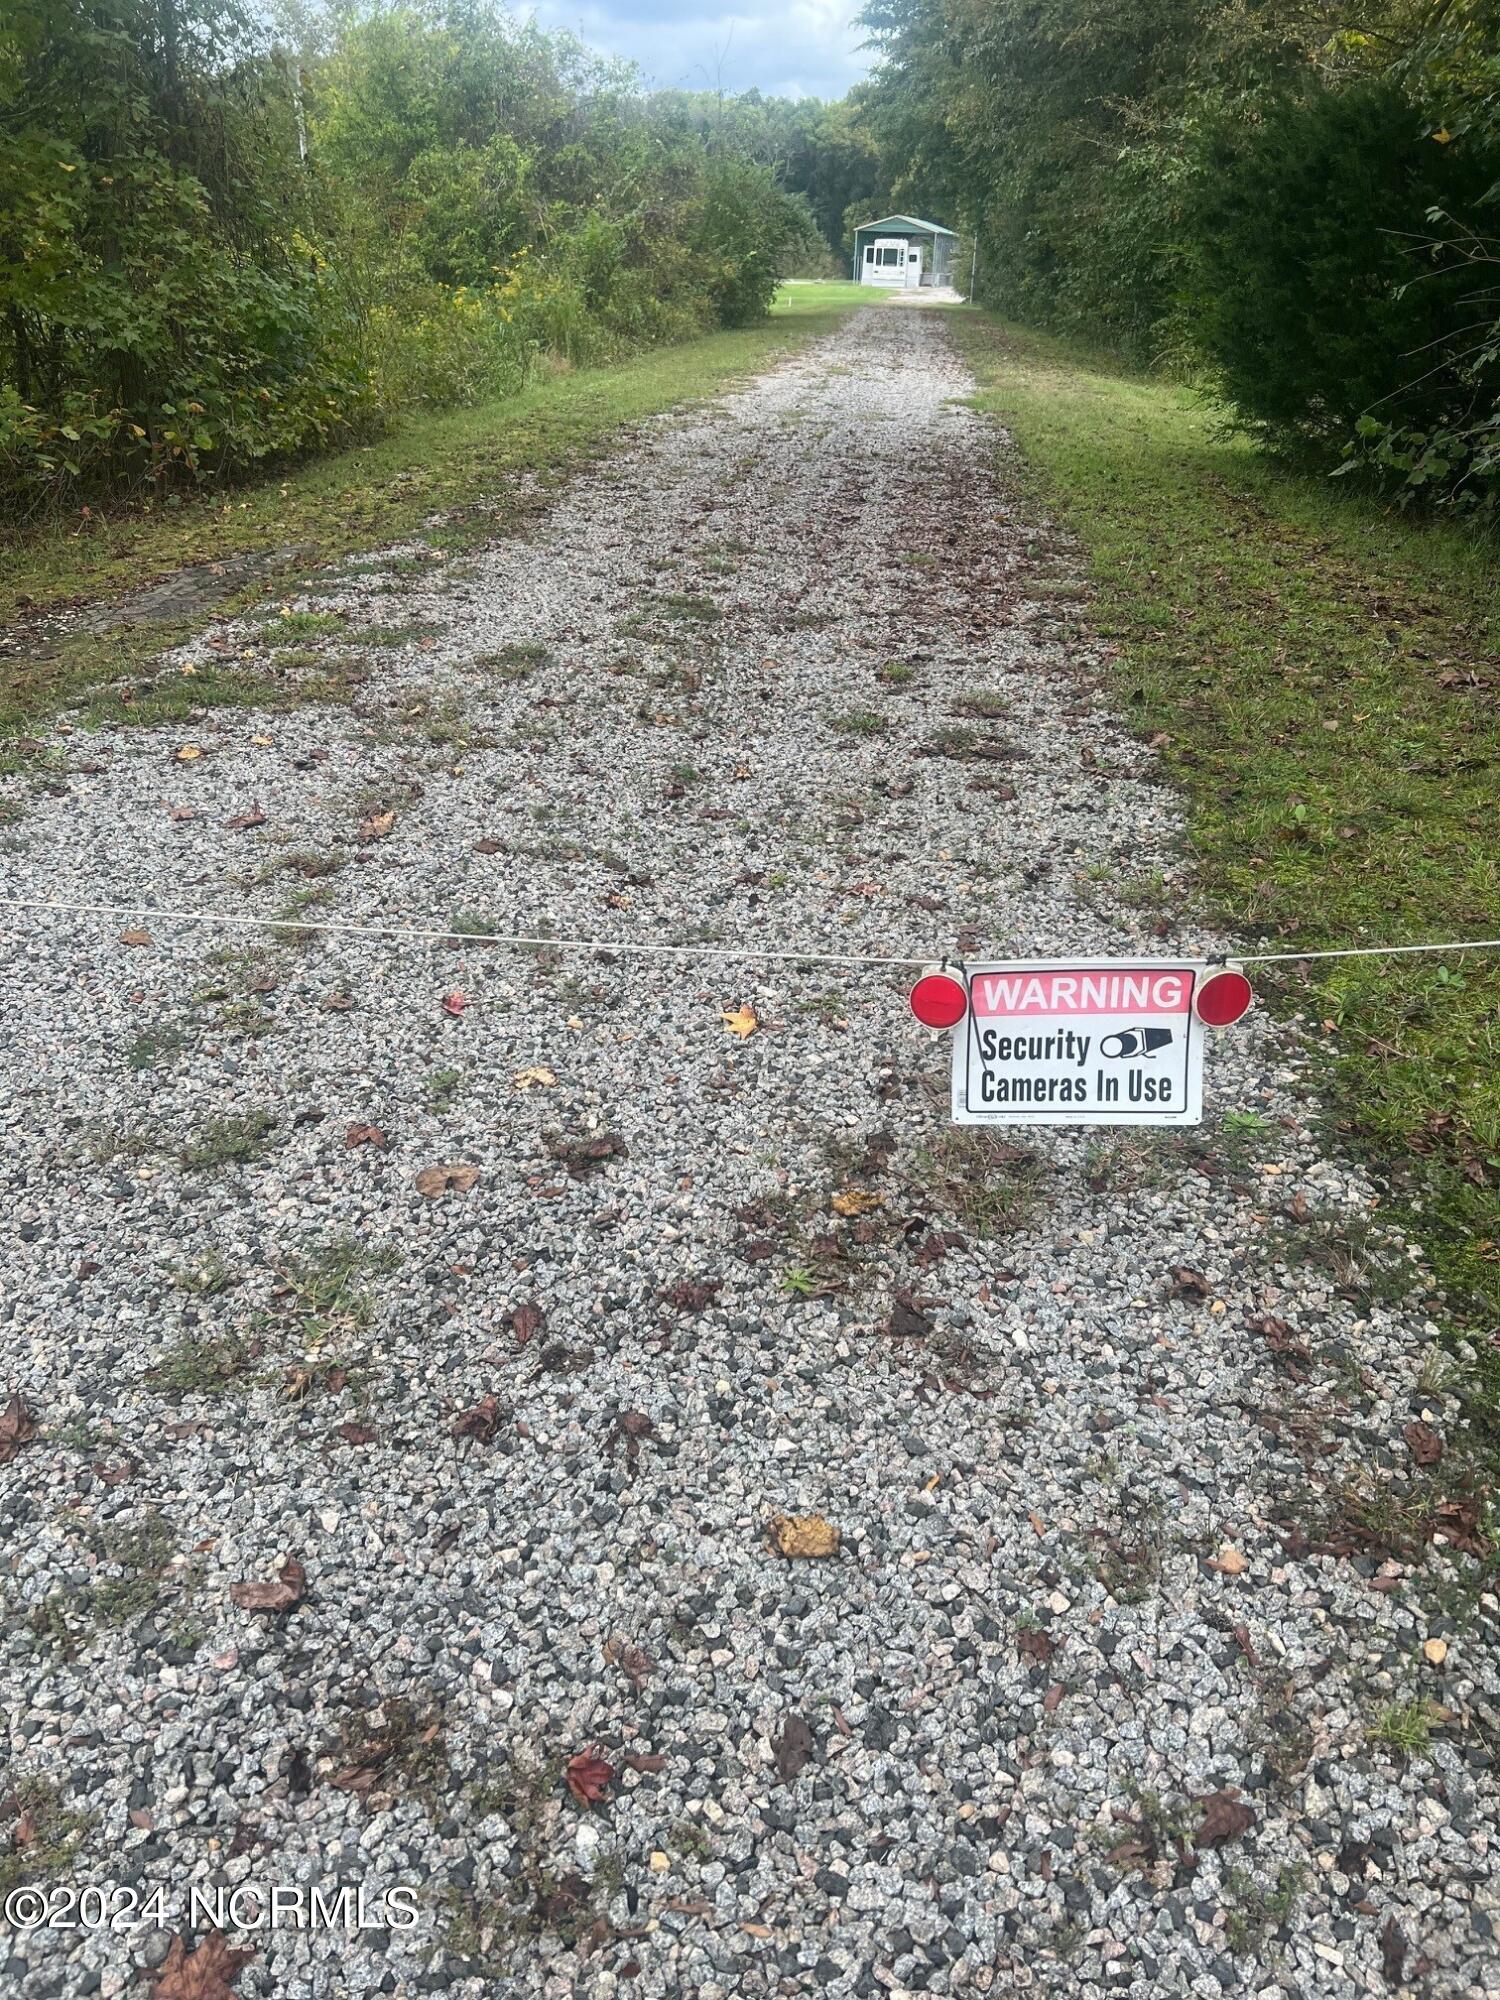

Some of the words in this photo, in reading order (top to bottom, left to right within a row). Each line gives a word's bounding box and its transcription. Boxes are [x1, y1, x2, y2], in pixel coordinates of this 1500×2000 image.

[983, 976, 1182, 1011] WARNING
[982, 1028, 1091, 1066] Security
[981, 1069, 1087, 1102] Cameras
[1097, 1069, 1119, 1101] In
[1129, 1069, 1172, 1102] Use
